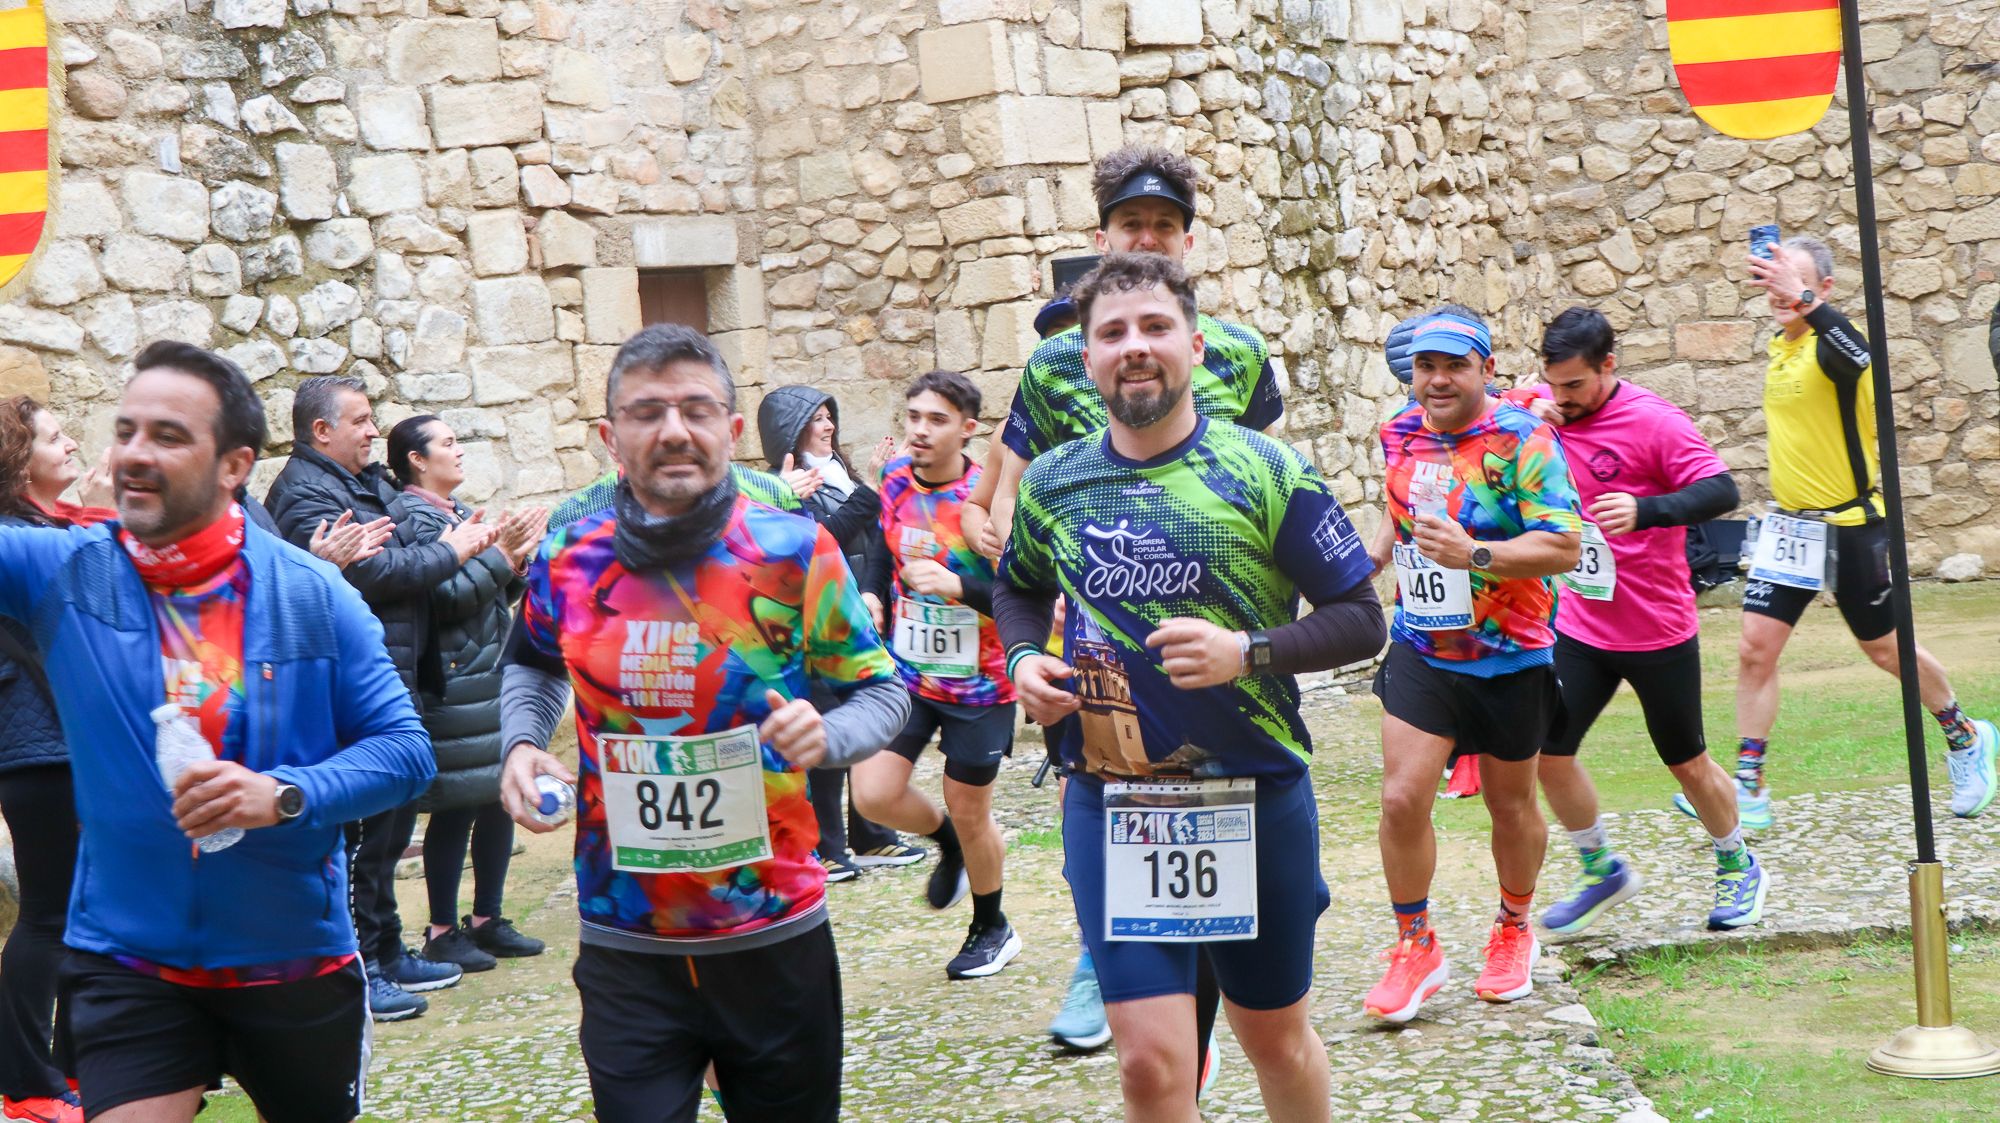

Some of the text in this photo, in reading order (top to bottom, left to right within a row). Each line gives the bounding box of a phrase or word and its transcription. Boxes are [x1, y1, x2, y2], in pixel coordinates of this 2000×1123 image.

[1143, 184, 1161, 193] ipso
[1132, 538, 1166, 546] CARRERA
[1133, 546, 1167, 554] POPULAR
[1143, 552, 1177, 561] CORONIL
[1775, 537, 1807, 567] 641
[1084, 561, 1201, 598] CORRER
[622, 620, 699, 653] XII 08
[907, 624, 961, 654] 1161
[620, 655, 669, 672] MEDIA
[620, 670, 695, 691] MARATÓN
[631, 690, 660, 706] 10K
[612, 740, 661, 774] 10K
[636, 778, 724, 831] 842
[1128, 812, 1172, 843] 21K
[1143, 849, 1218, 899] 136
